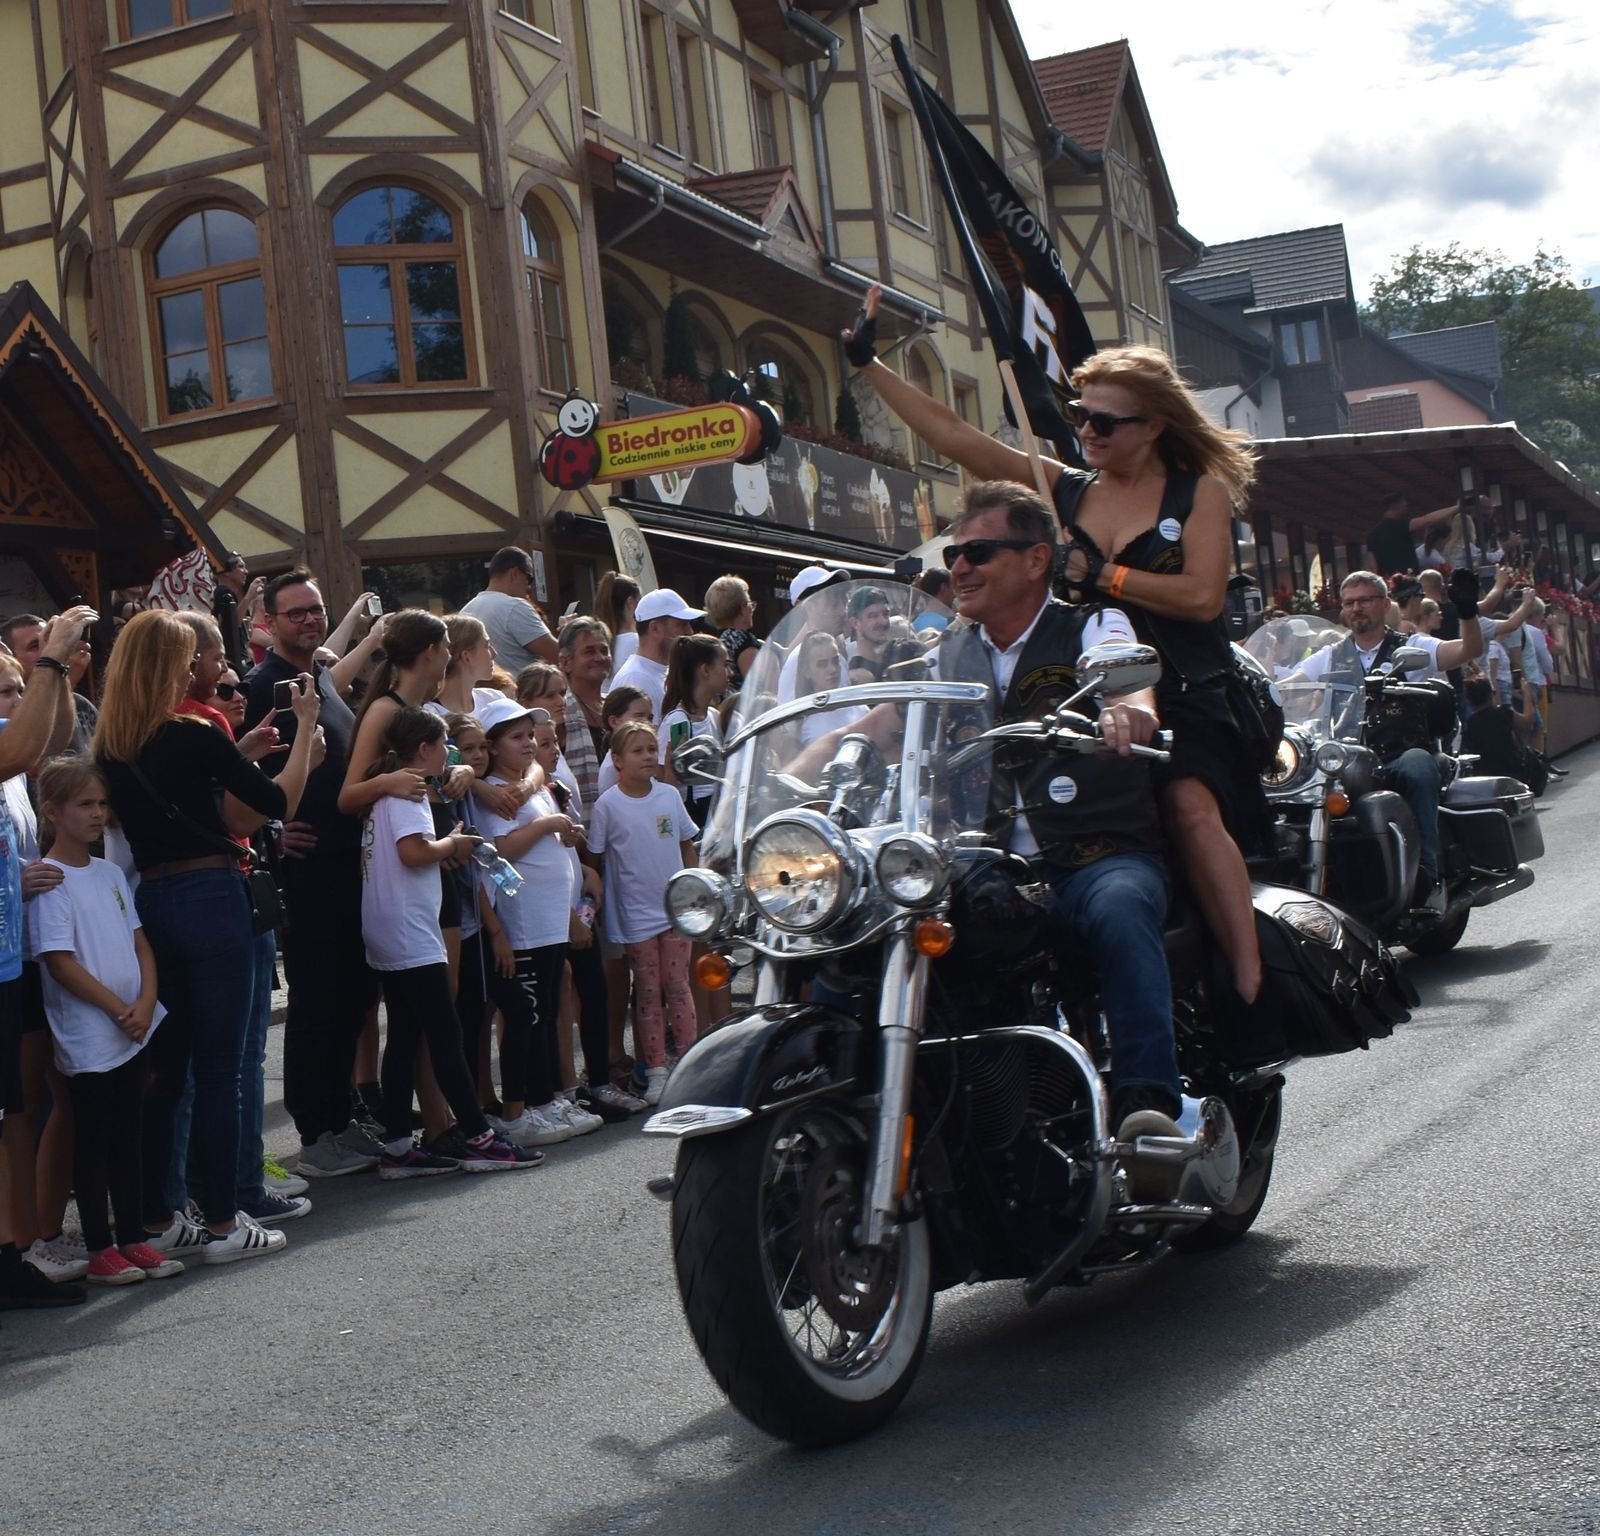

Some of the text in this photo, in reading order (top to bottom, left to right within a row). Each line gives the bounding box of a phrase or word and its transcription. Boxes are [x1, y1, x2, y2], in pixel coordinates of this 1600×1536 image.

[607, 417, 735, 454] Biedronka
[609, 437, 737, 467] Codziennie niskie ceny
